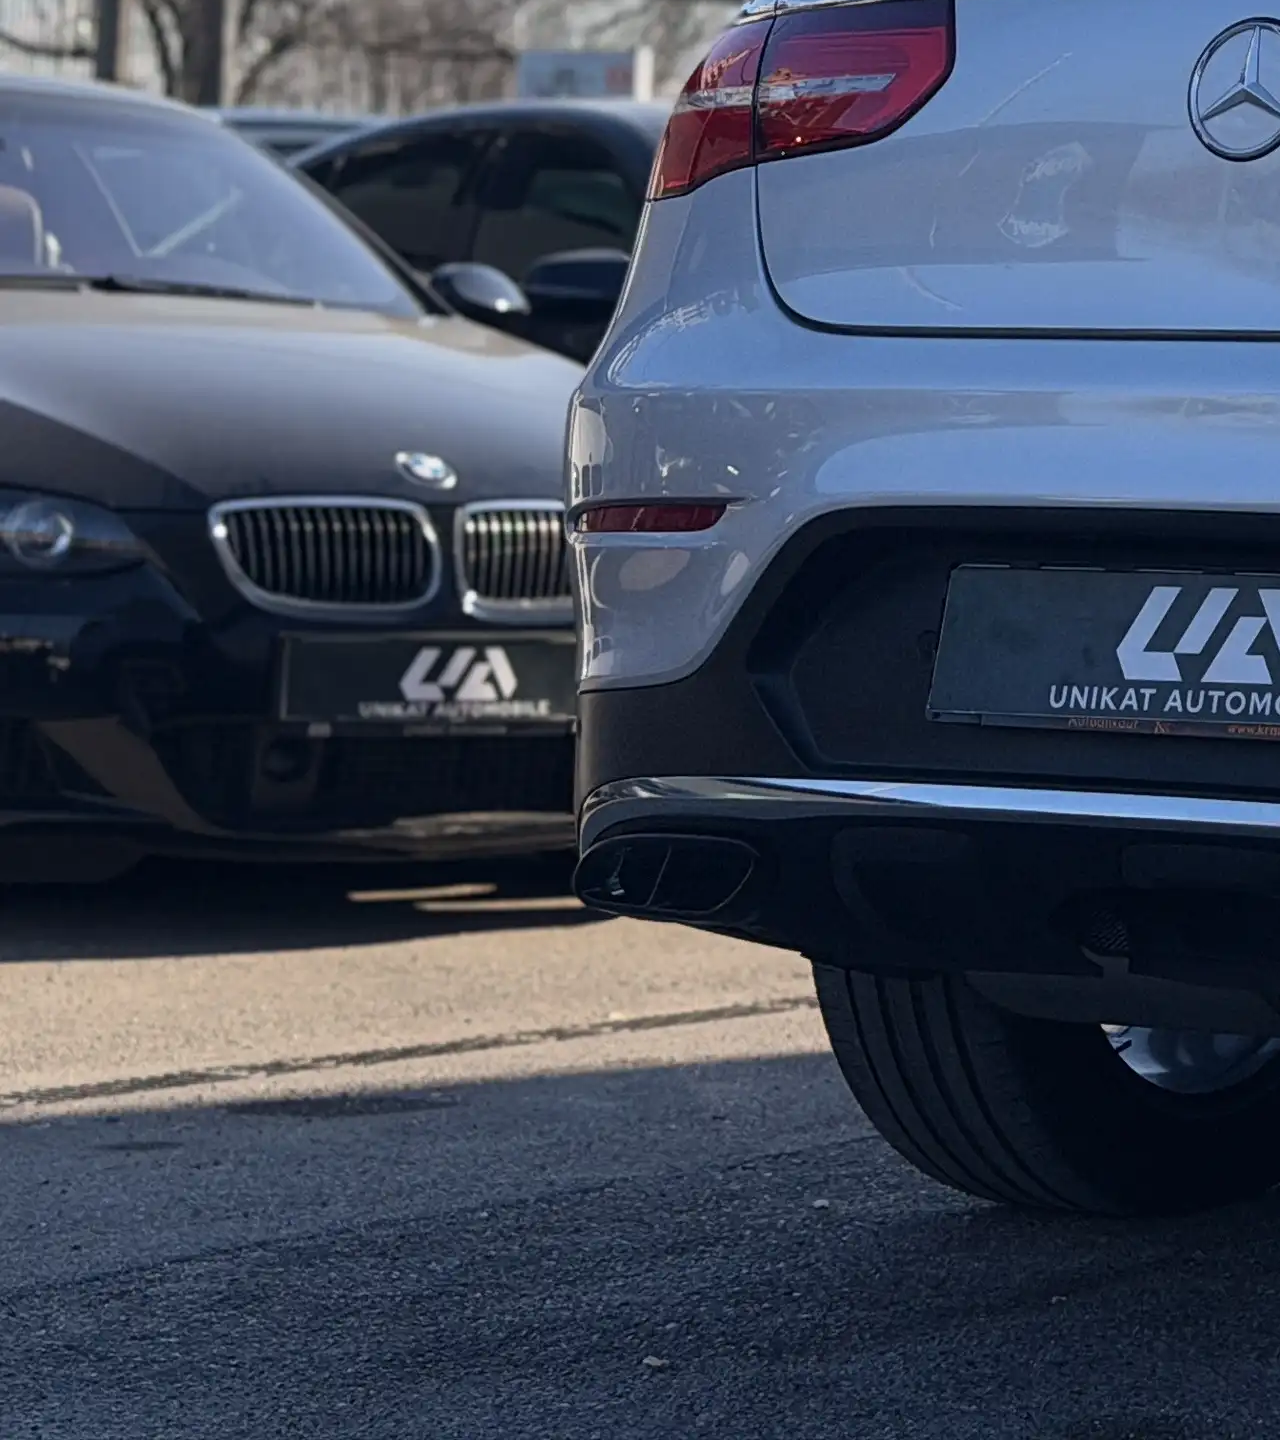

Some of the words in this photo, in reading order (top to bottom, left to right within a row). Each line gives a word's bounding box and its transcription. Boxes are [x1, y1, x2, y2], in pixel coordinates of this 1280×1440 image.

[358, 700, 429, 718] UNIKAT
[433, 698, 550, 718] AUTOMOBILE
[1049, 685, 1157, 713] UNIKAT
